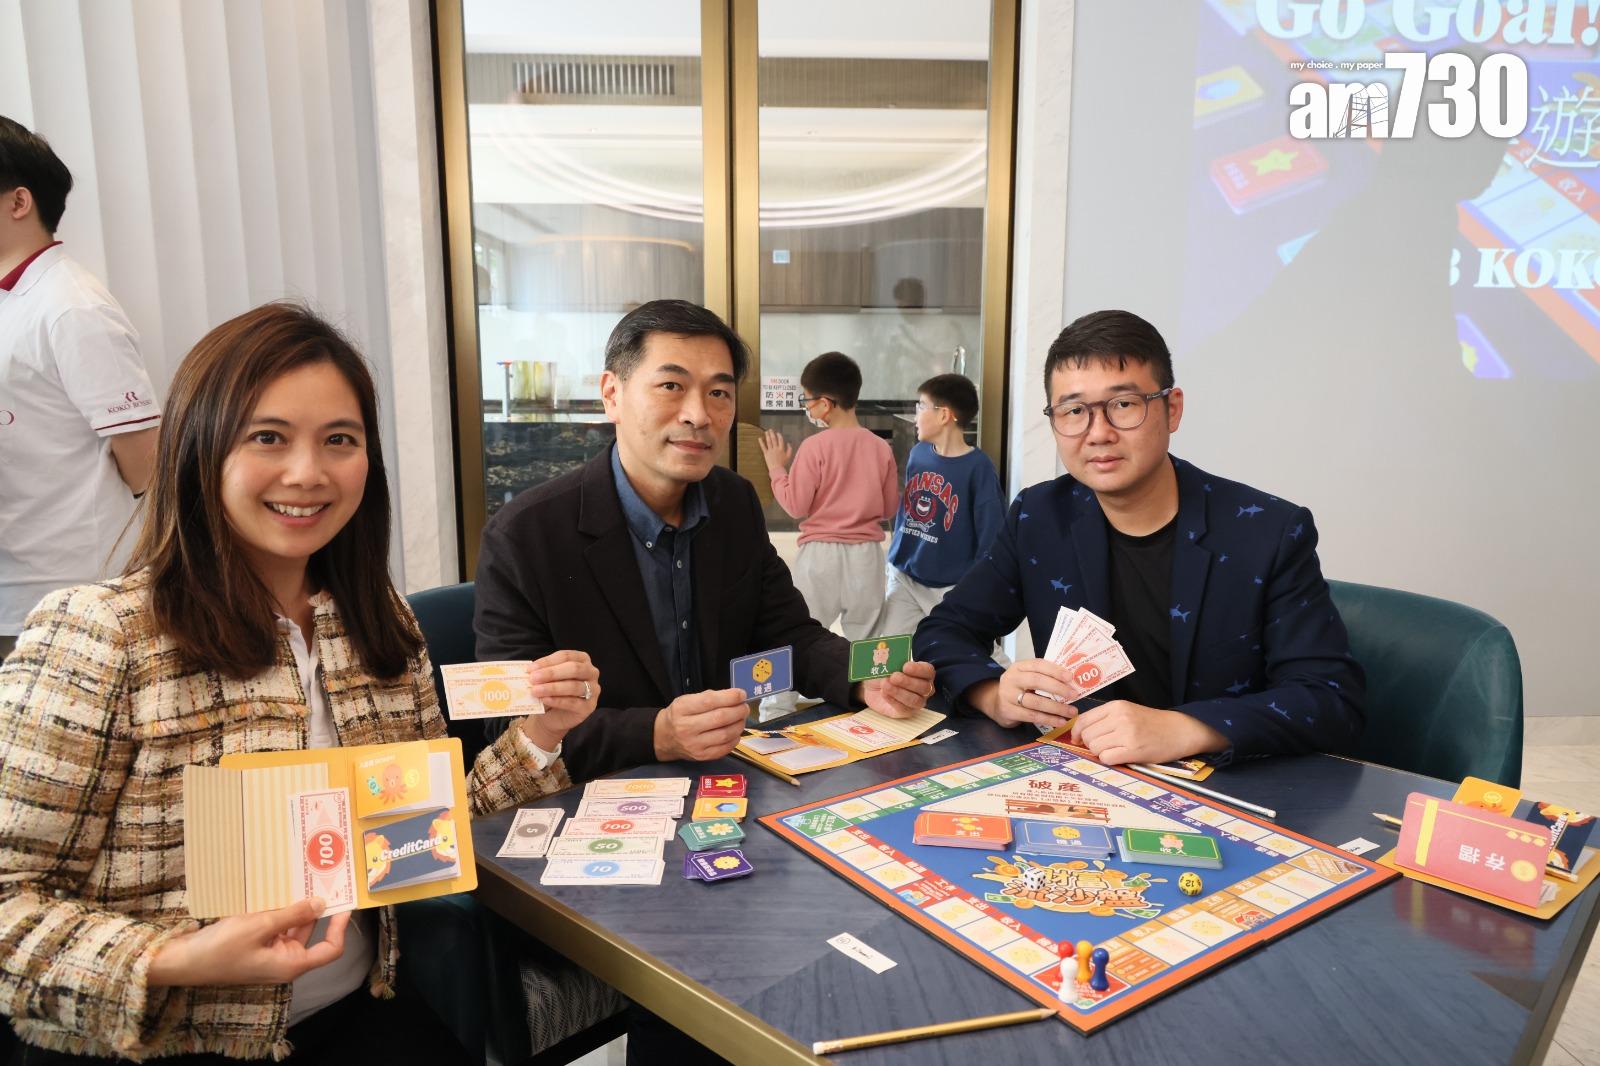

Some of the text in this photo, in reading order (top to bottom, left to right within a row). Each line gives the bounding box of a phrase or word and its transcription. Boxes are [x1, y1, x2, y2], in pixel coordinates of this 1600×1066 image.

[1255, 0, 1365, 39] Go
[1473, 247, 1600, 289] KOK
[765, 391, 794, 399] 防火門
[107, 403, 130, 414] KOKO
[870, 664, 889, 675] 收入
[1077, 667, 1099, 685] 100
[483, 690, 510, 701] 1000
[624, 783, 655, 791] 1000
[620, 804, 648, 813] 500
[526, 827, 539, 835] 5
[603, 822, 632, 831] 100
[319, 833, 335, 866] 100
[380, 836, 445, 861] CreditCard
[597, 842, 618, 850] 50
[591, 864, 611, 873] 10
[1184, 879, 1195, 888] 12
